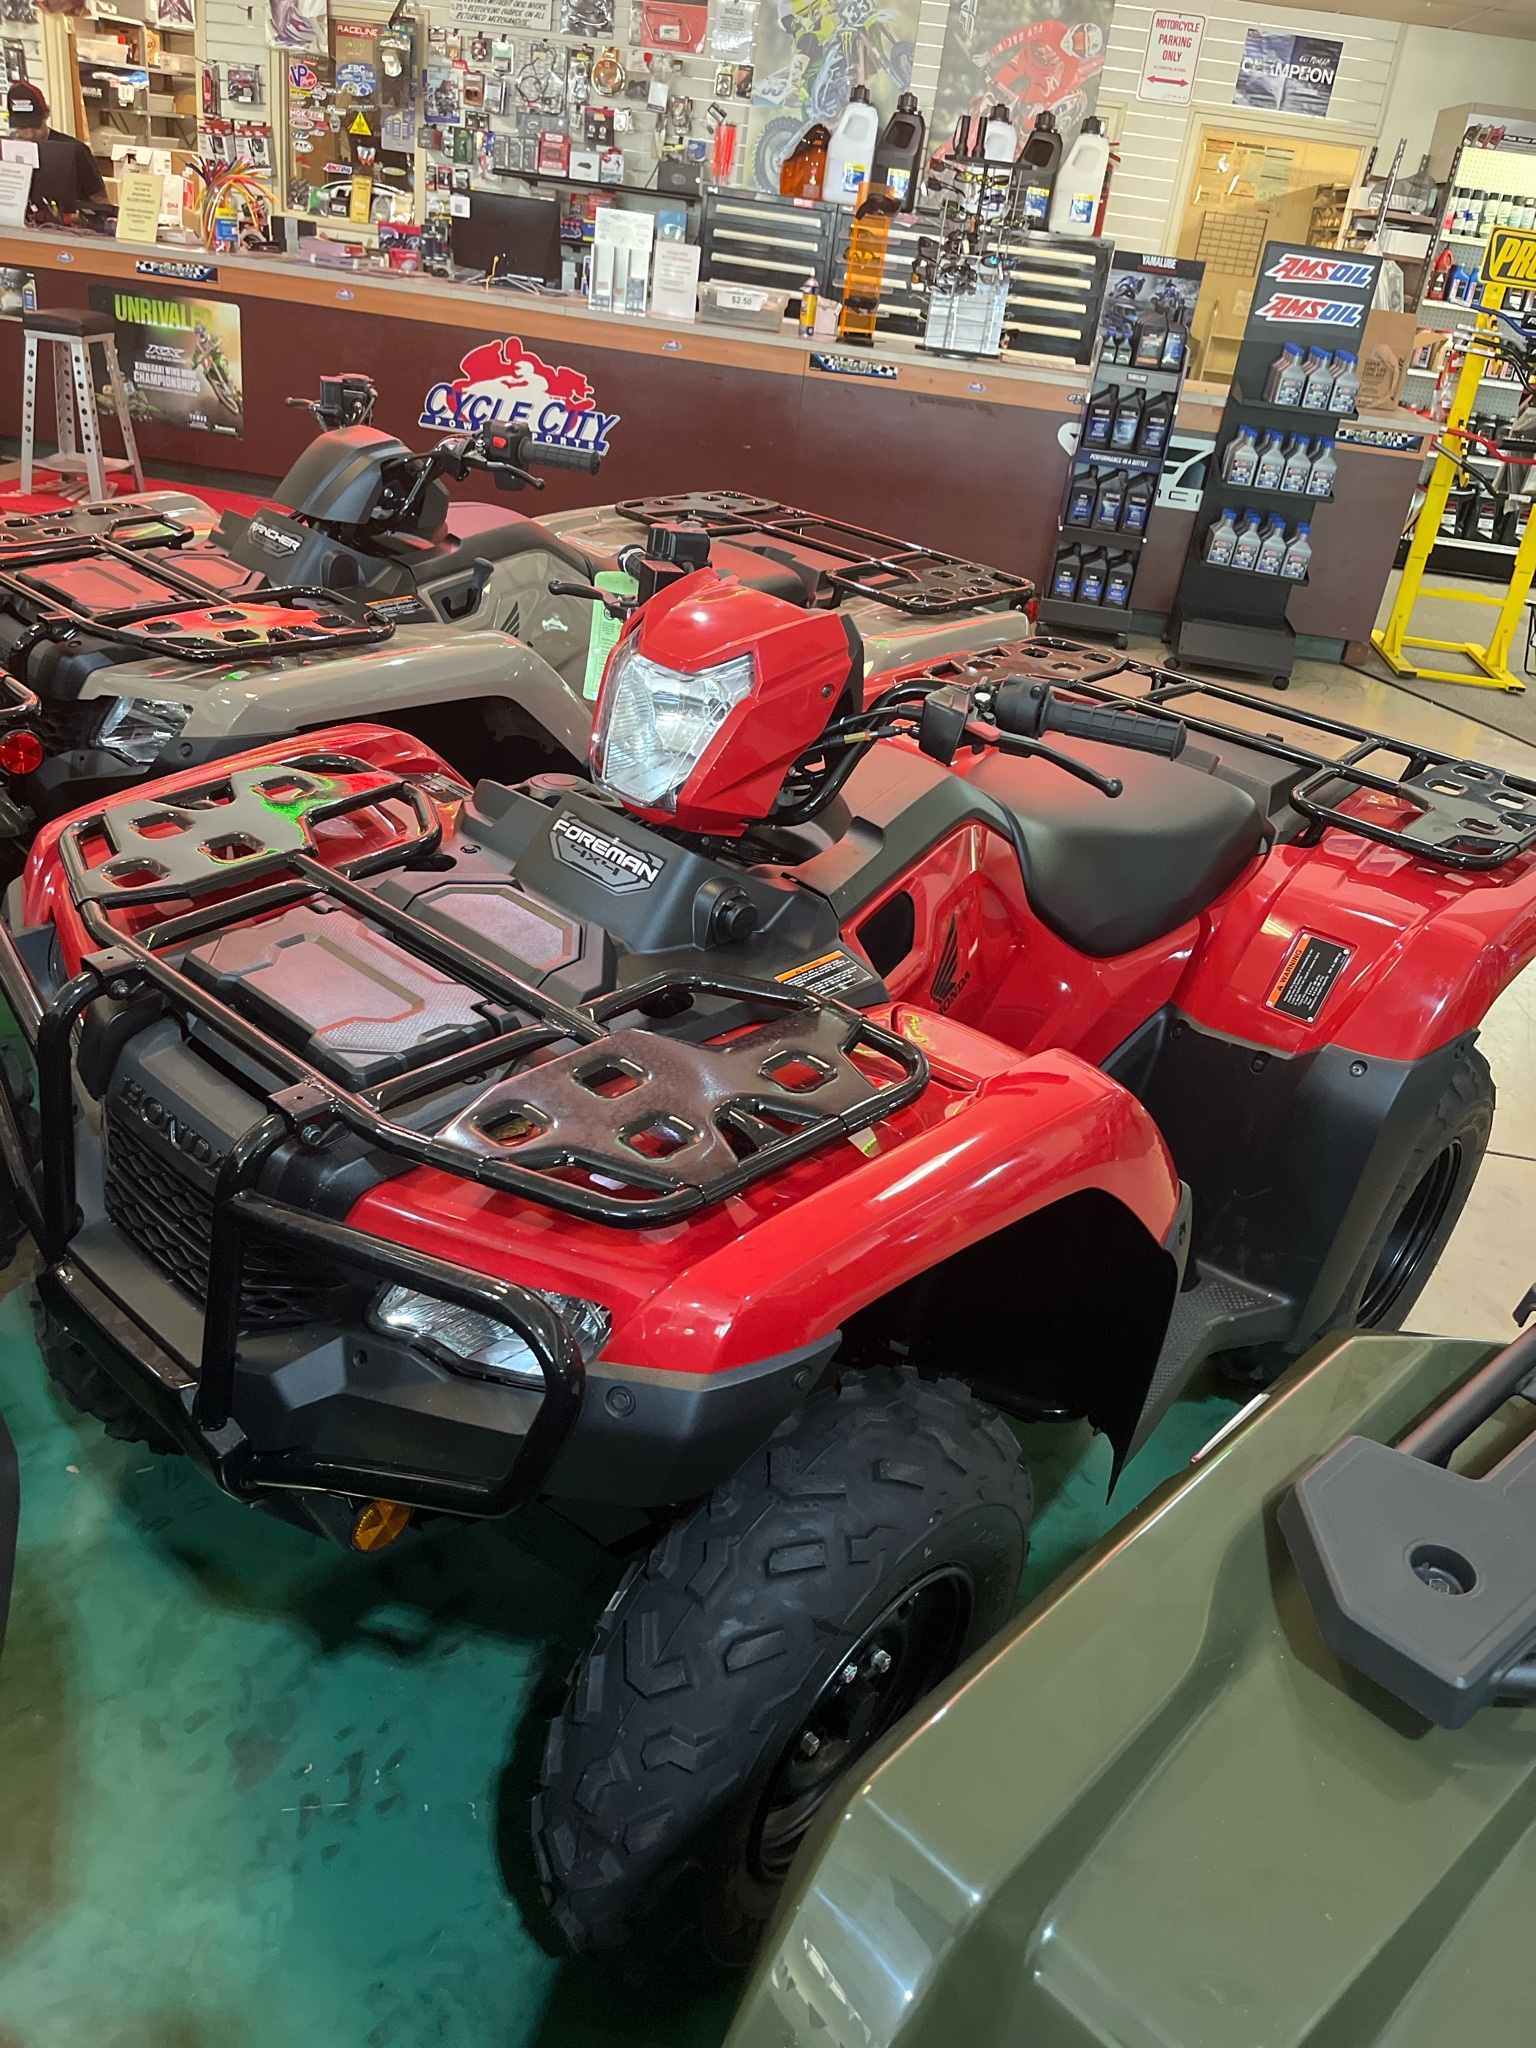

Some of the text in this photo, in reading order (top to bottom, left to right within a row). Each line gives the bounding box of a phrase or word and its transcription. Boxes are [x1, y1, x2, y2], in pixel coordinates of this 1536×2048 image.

[456, 12, 530, 26] RETURNED MERCHANDISE
[534, 12, 545, 20] ALL
[1155, 18, 1200, 33] MOTORCYCLE
[337, 25, 379, 36] RACELINE
[1158, 34, 1193, 48] PARKING
[1162, 49, 1183, 63] ONLY
[290, 64, 308, 88] VP
[347, 64, 366, 74] EBC
[325, 163, 352, 174] AMSOIL
[1142, 254, 1177, 270] YAMALUBE
[1268, 255, 1373, 287] AMSOIL
[114, 294, 214, 333] UNRIVALED
[1258, 294, 1363, 326] AMSOIL
[133, 370, 201, 393] CHAMPIONSHIPS
[426, 384, 616, 442] CYCLE CITY
[1090, 453, 1121, 465] PERFORMANCE
[1132, 458, 1149, 468] BOTTLE
[250, 521, 301, 551] RANCHER
[552, 818, 659, 883] FOREMAN
[1281, 949, 1302, 983] WARNING
[936, 970, 971, 1015] HONDA
[119, 1074, 225, 1178] HONDA
